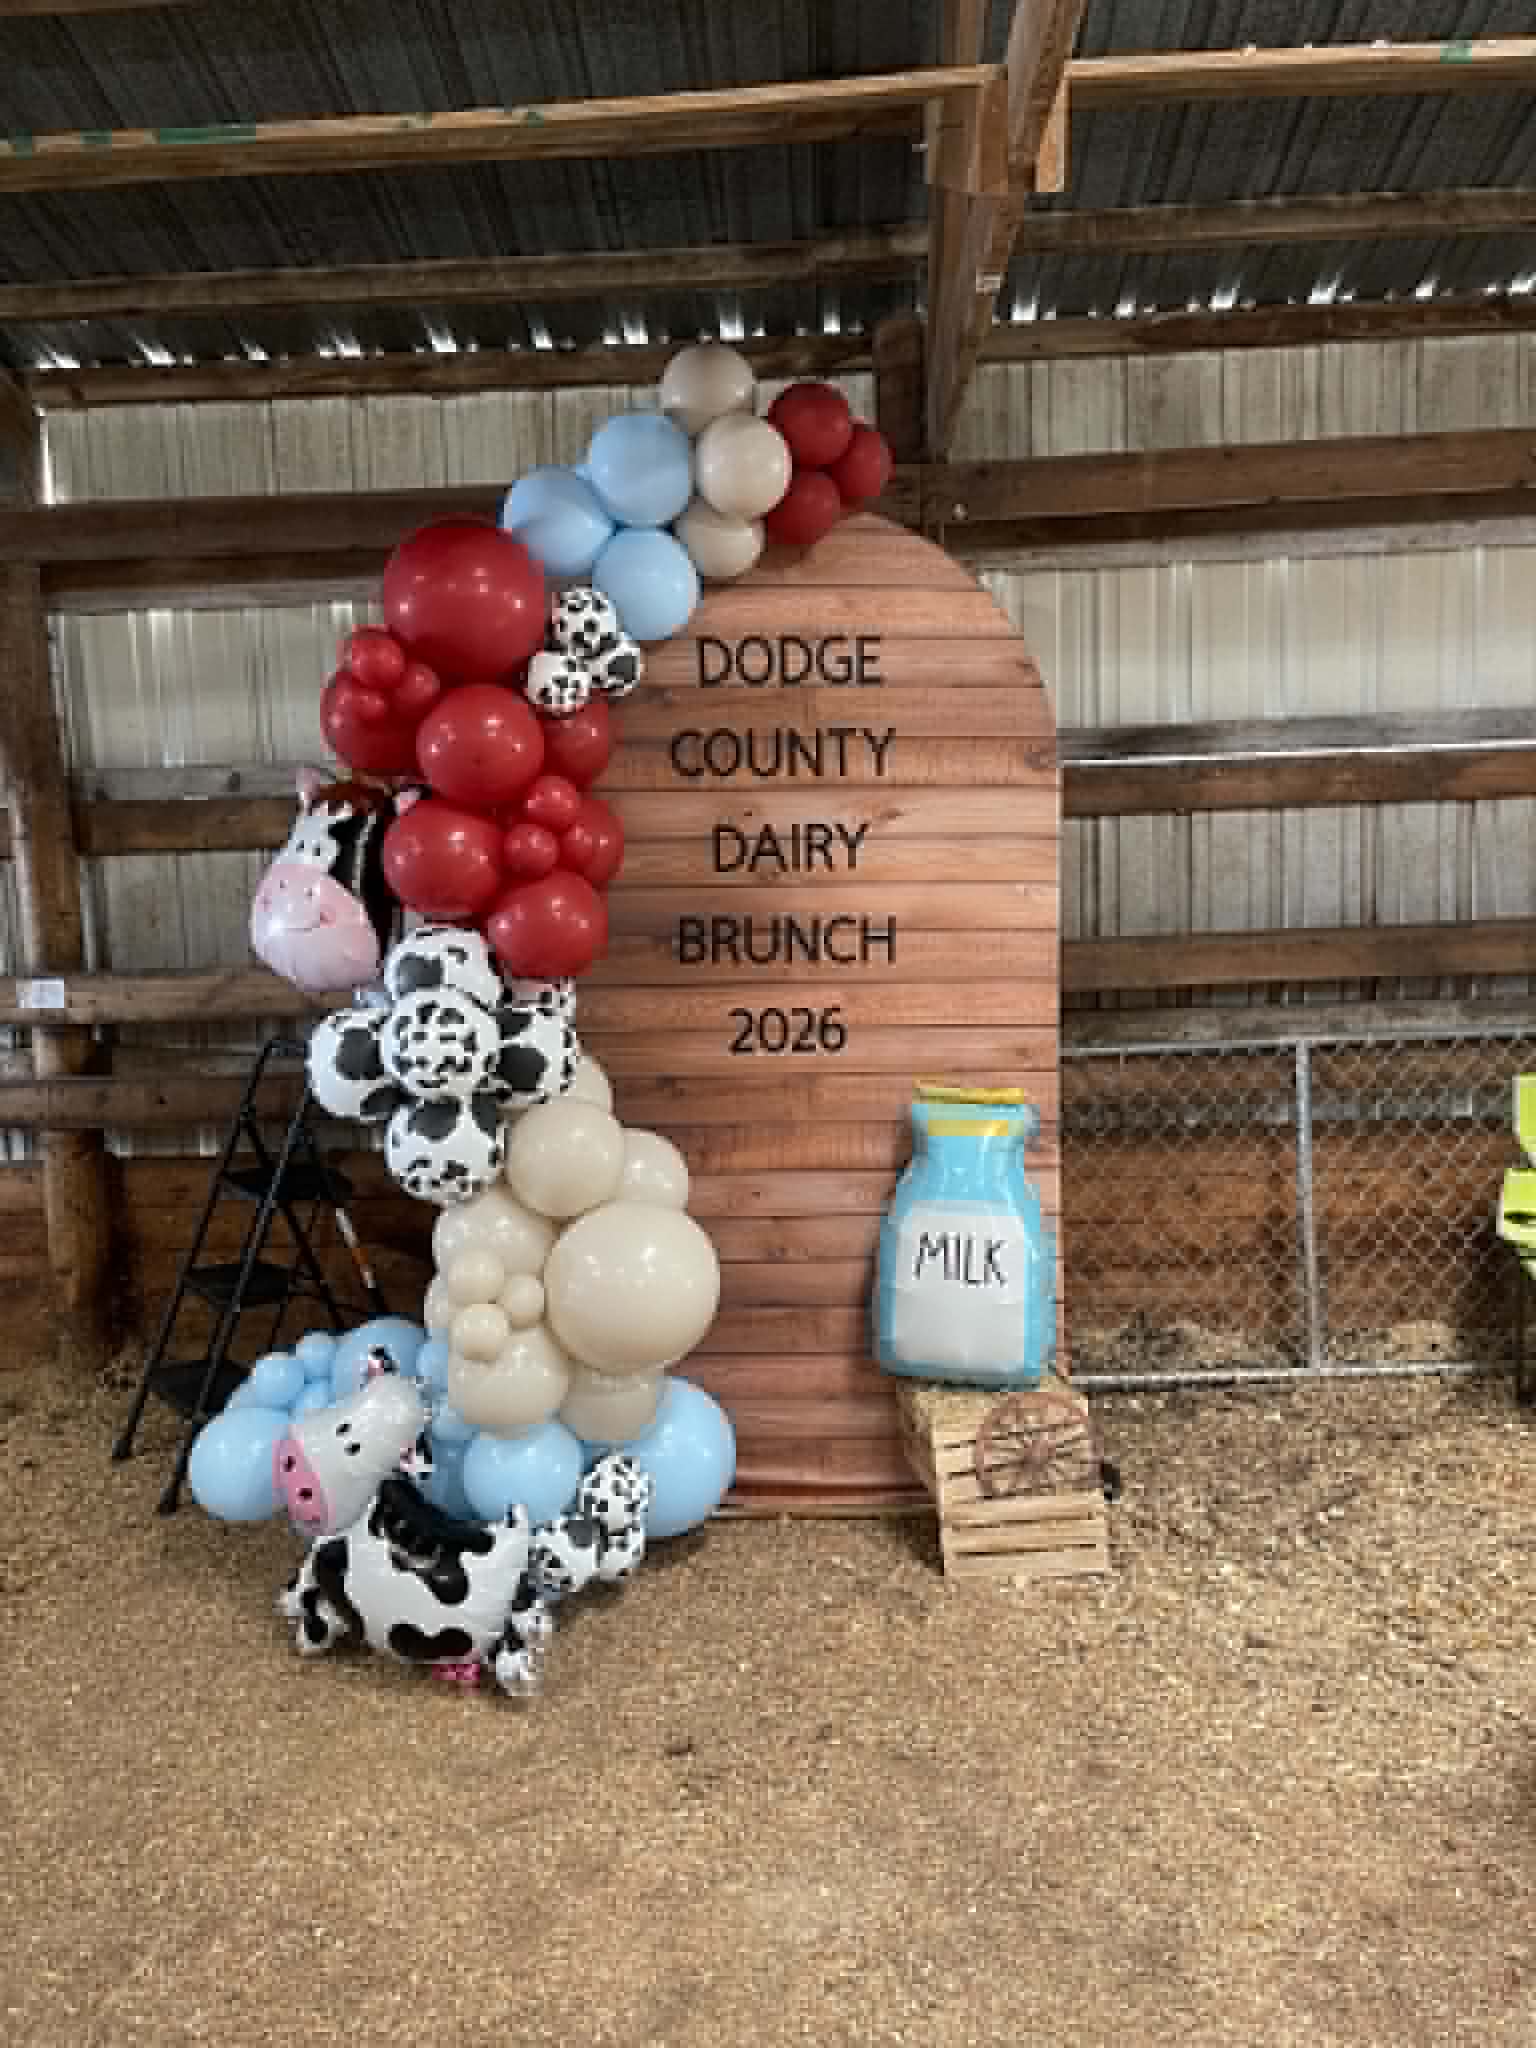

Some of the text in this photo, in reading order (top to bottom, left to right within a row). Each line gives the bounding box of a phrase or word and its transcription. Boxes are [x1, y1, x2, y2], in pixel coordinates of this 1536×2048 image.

[697, 635, 883, 687] DODGE
[671, 728, 897, 777] COUNTY
[712, 823, 869, 873] DAIRY
[678, 915, 897, 966] BRUNCH
[728, 1007, 848, 1054] 2026
[913, 1231, 1009, 1288] MILK
